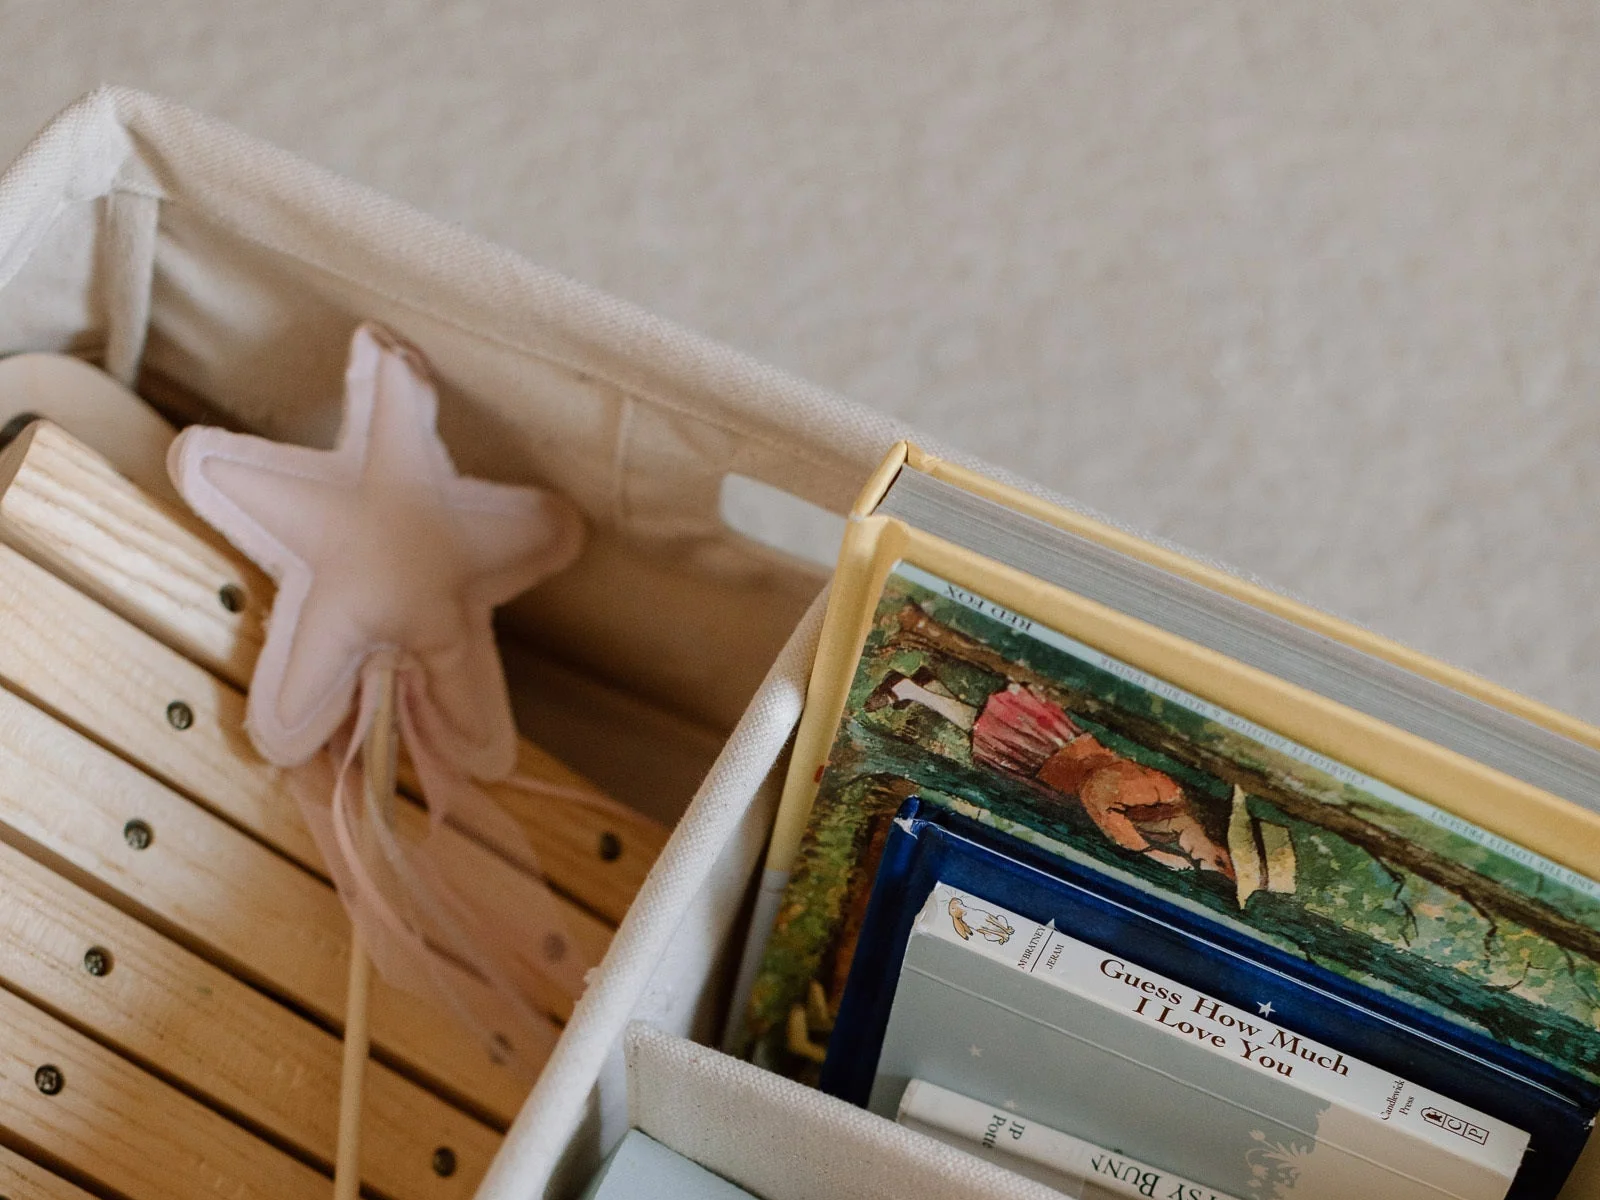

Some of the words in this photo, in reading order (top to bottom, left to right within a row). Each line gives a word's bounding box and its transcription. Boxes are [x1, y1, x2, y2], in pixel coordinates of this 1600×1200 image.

[944, 584, 985, 610] FOX
[991, 606, 1033, 632] RED
[1045, 943, 1065, 970] JERAM
[1099, 958, 1183, 1005] Guess
[1190, 995, 1263, 1037] How
[1268, 1028, 1349, 1077] Much
[1132, 995, 1153, 1016] I
[1154, 1004, 1226, 1048] Love
[1240, 1038, 1294, 1077] You
[1380, 1079, 1405, 1121] Candlewick
[1398, 1095, 1415, 1116] Press
[1009, 1120, 1026, 1141] JP
